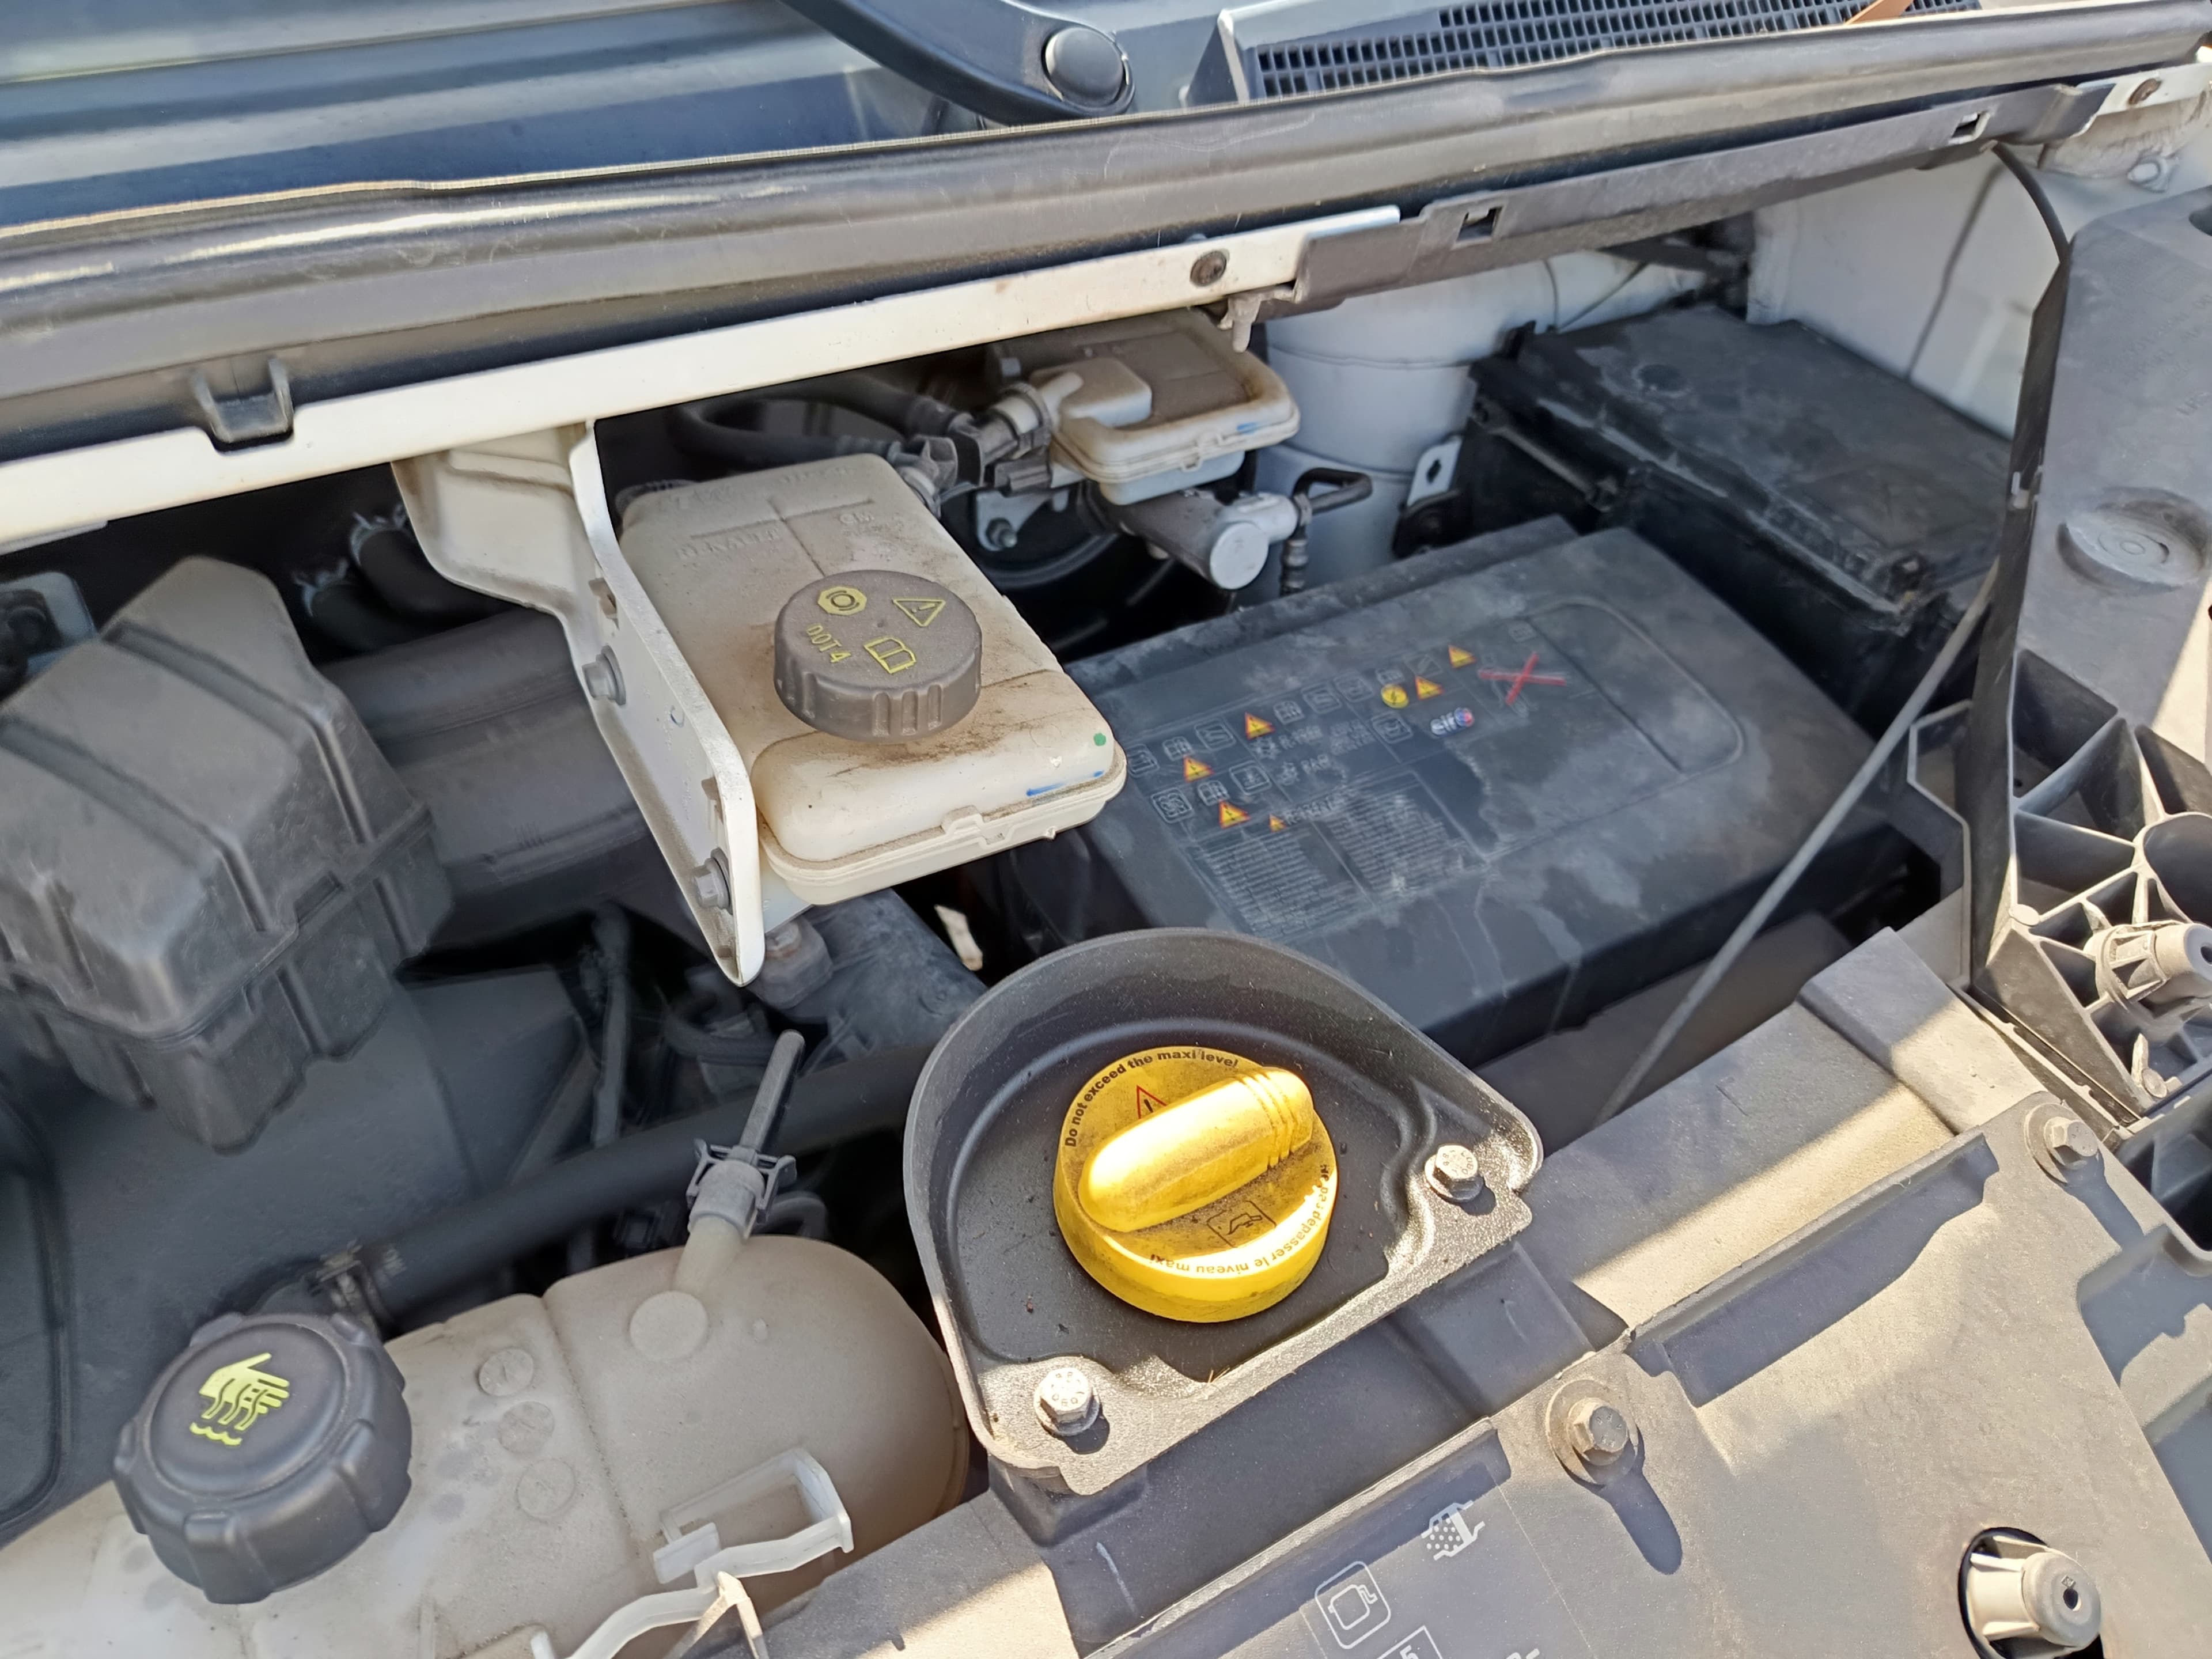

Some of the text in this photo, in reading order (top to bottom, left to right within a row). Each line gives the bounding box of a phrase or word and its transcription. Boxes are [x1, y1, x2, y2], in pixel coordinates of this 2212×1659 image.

[806, 624, 851, 663] DOT 4
[1065, 1050, 1238, 1147] Do not exceed the maxi level
[1150, 1254, 1190, 1272] maxi
[1196, 1263, 1249, 1274] niveau
[1255, 1258, 1270, 1267] le
